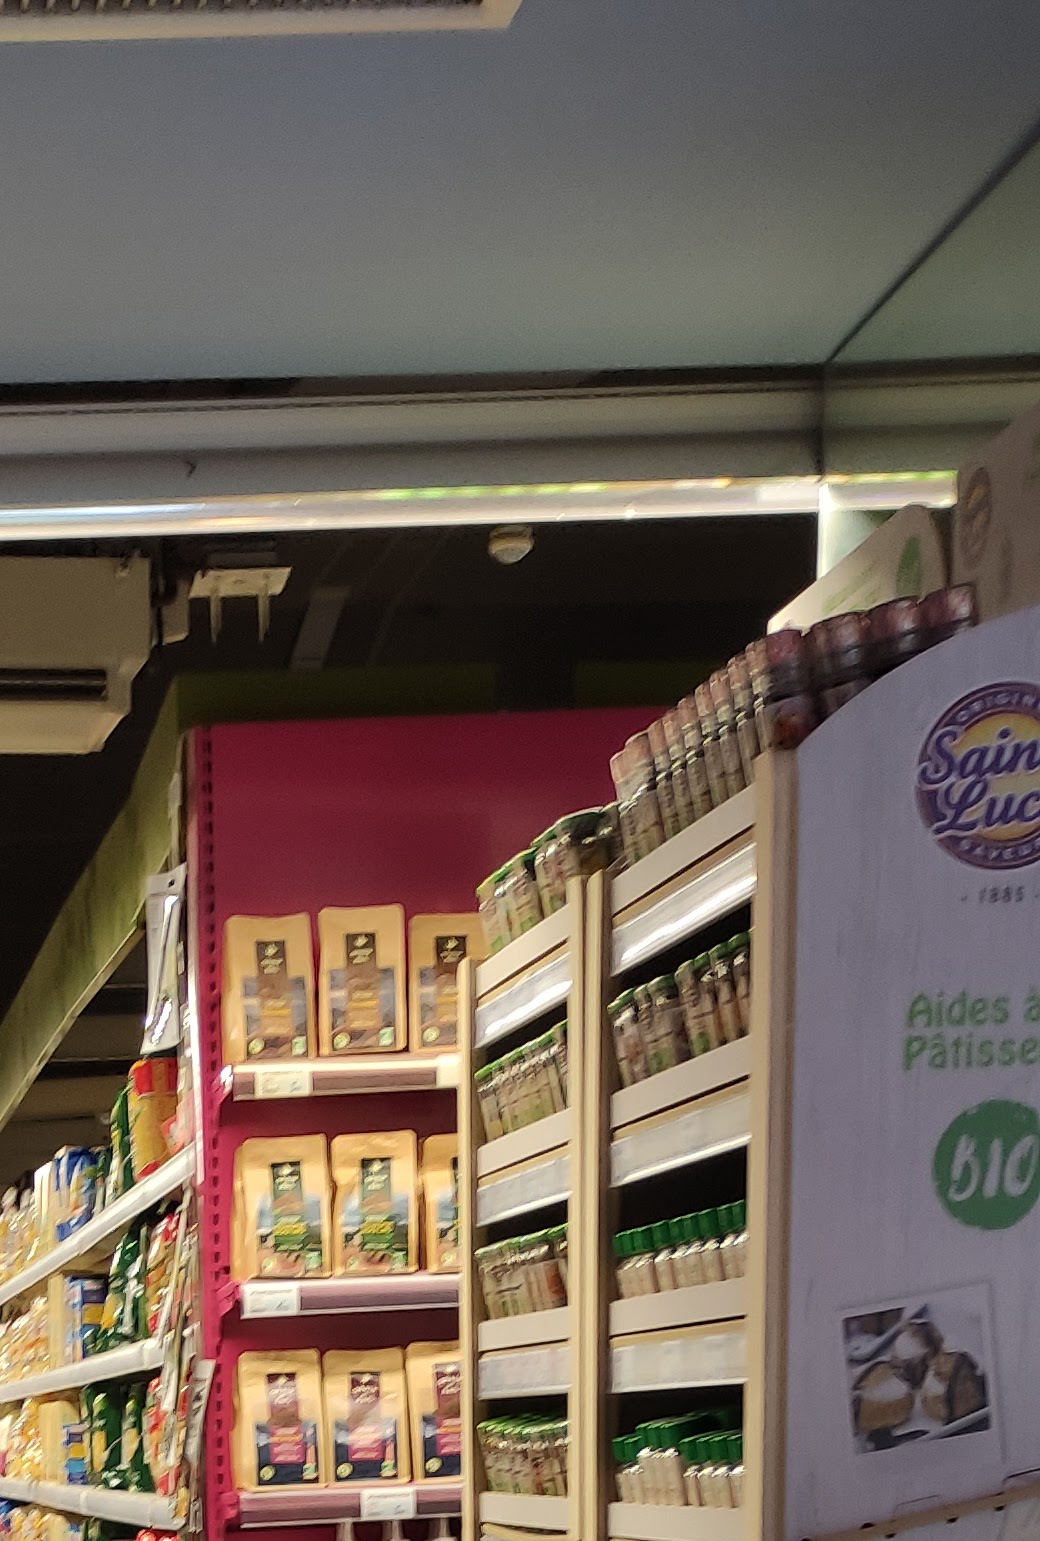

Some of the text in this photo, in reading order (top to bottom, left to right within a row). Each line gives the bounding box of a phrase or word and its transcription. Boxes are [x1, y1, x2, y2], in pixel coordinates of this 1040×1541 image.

[907, 990, 1009, 1028] Aides
[904, 1032, 1040, 1070] Pâtisse
[948, 1133, 1038, 1202] BIO
